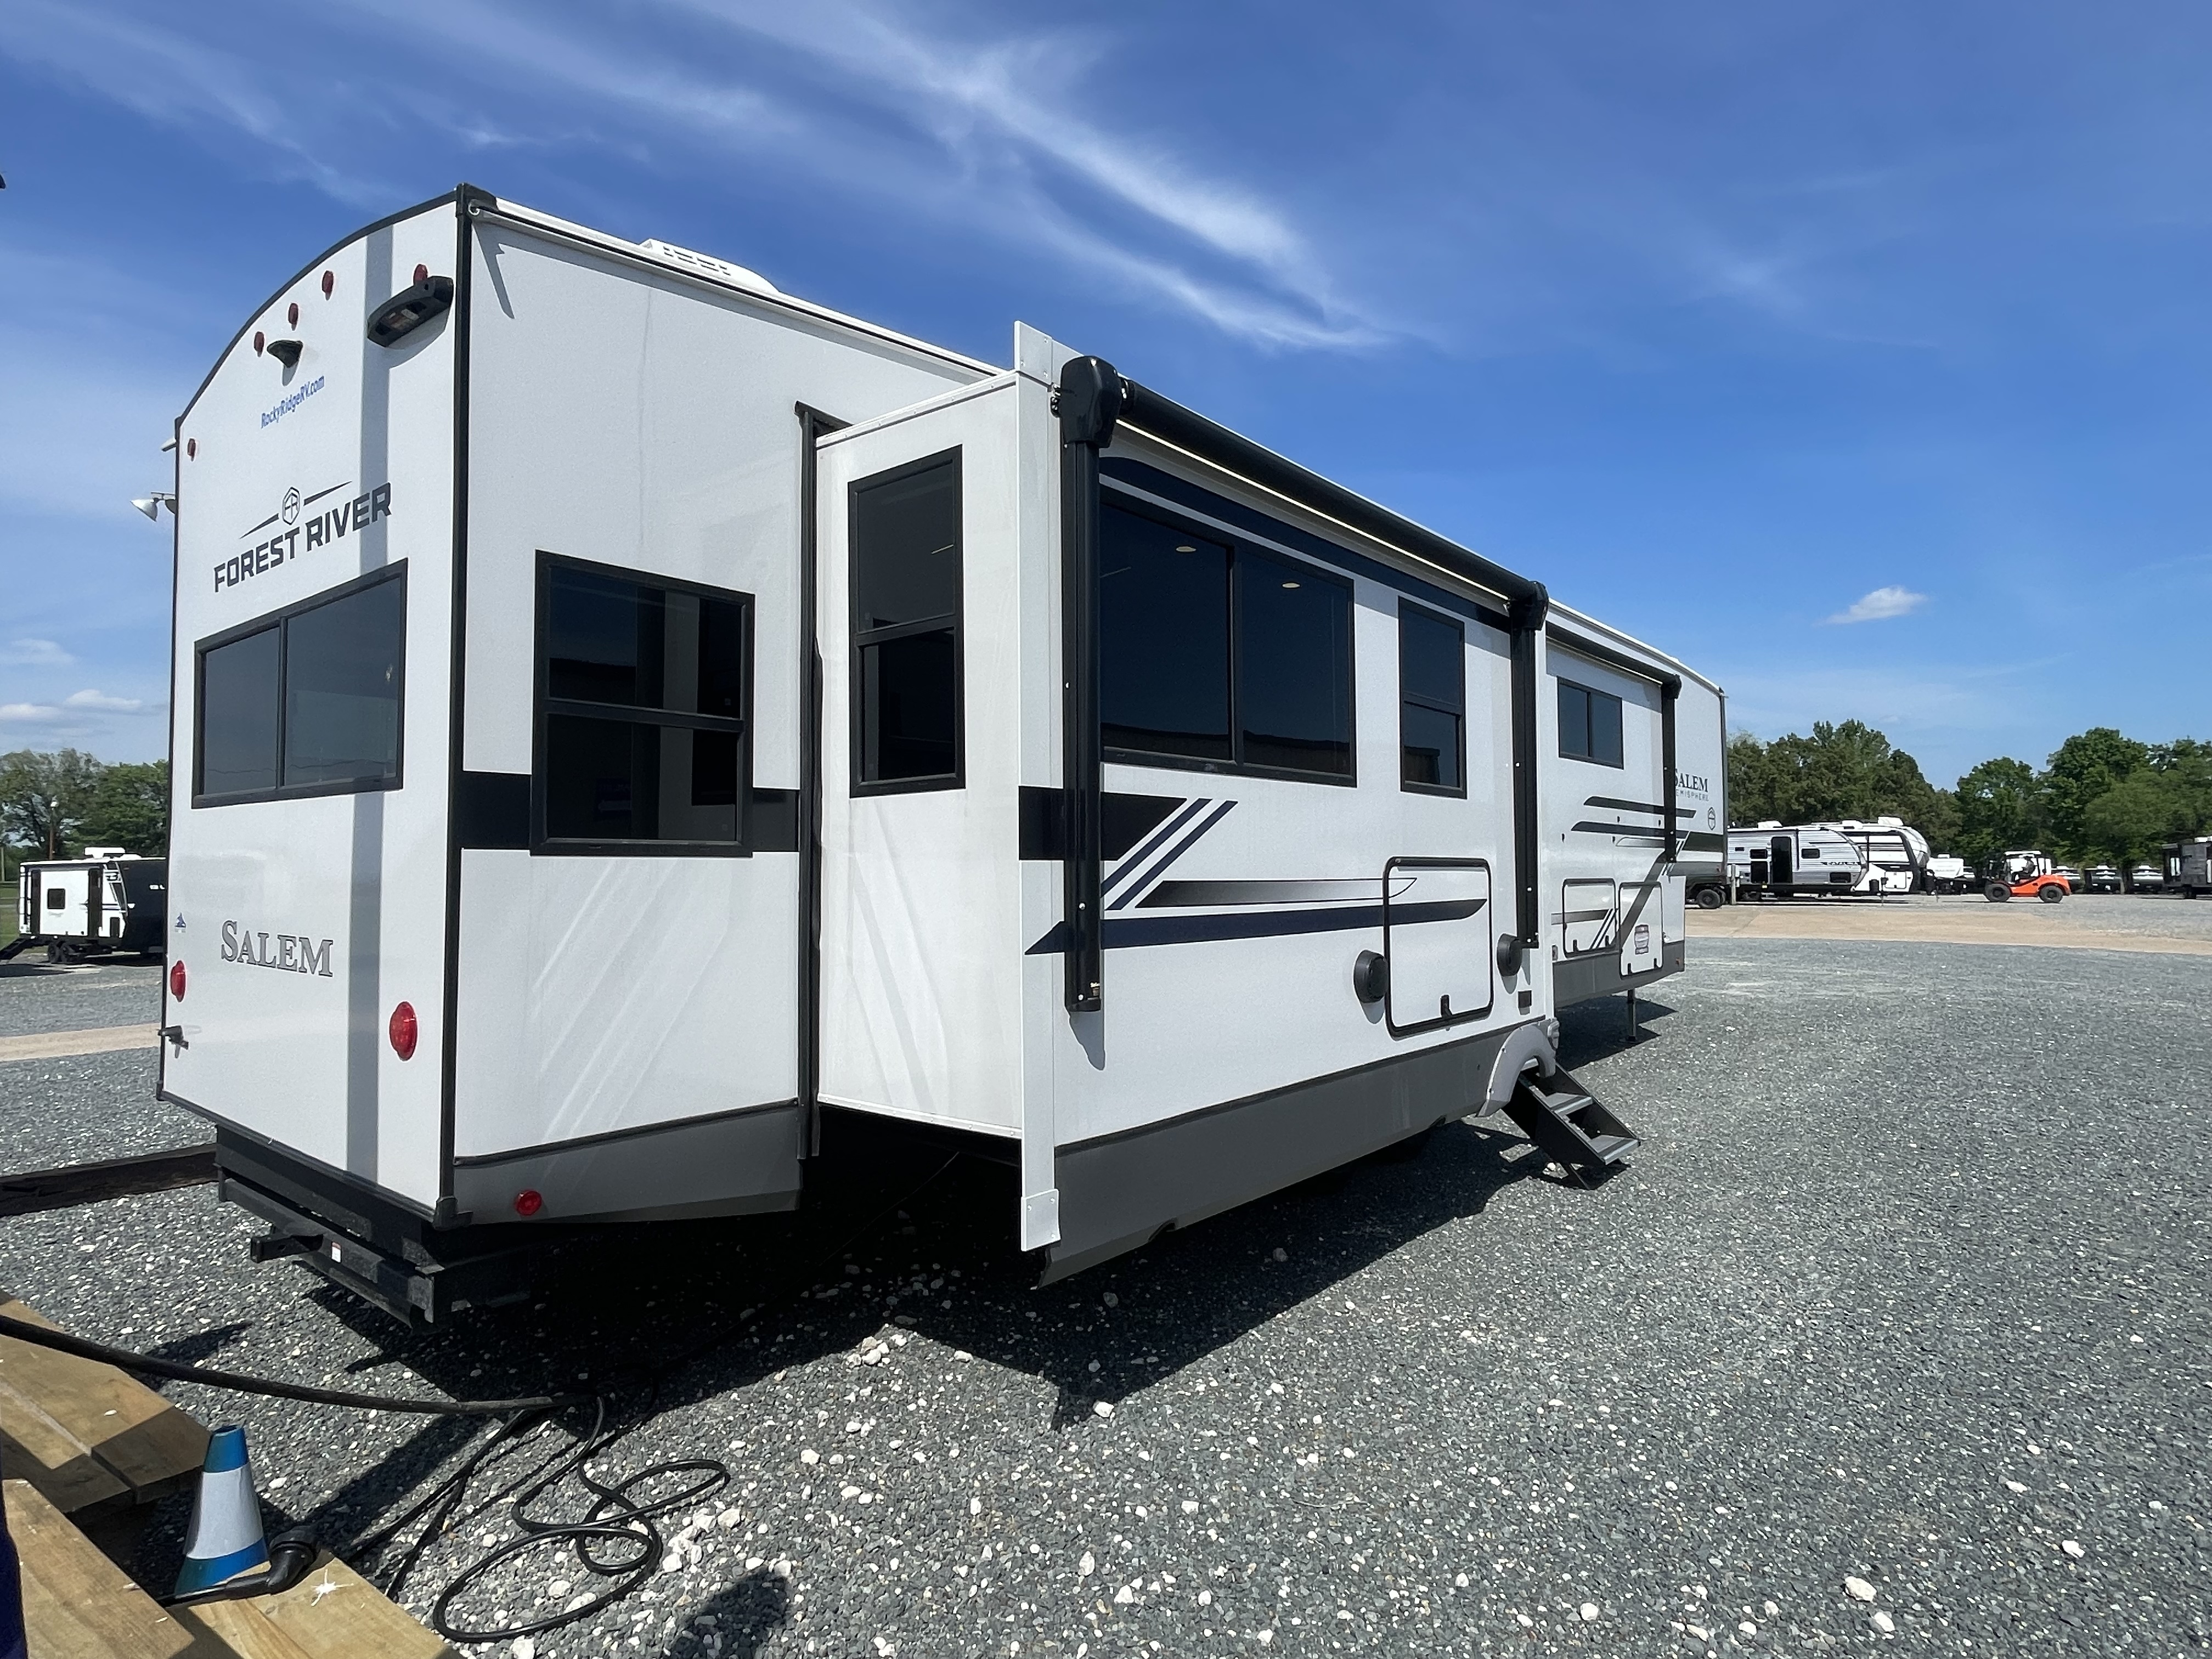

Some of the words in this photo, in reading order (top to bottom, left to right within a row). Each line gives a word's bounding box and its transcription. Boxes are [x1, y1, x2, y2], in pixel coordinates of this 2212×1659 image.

[261, 375, 324, 428] RockyRidgeRV.com
[213, 527, 300, 593] FOREST
[305, 482, 392, 552] RIVER
[1675, 789, 1709, 802] EMISPHERE
[221, 919, 333, 977] SALEM
